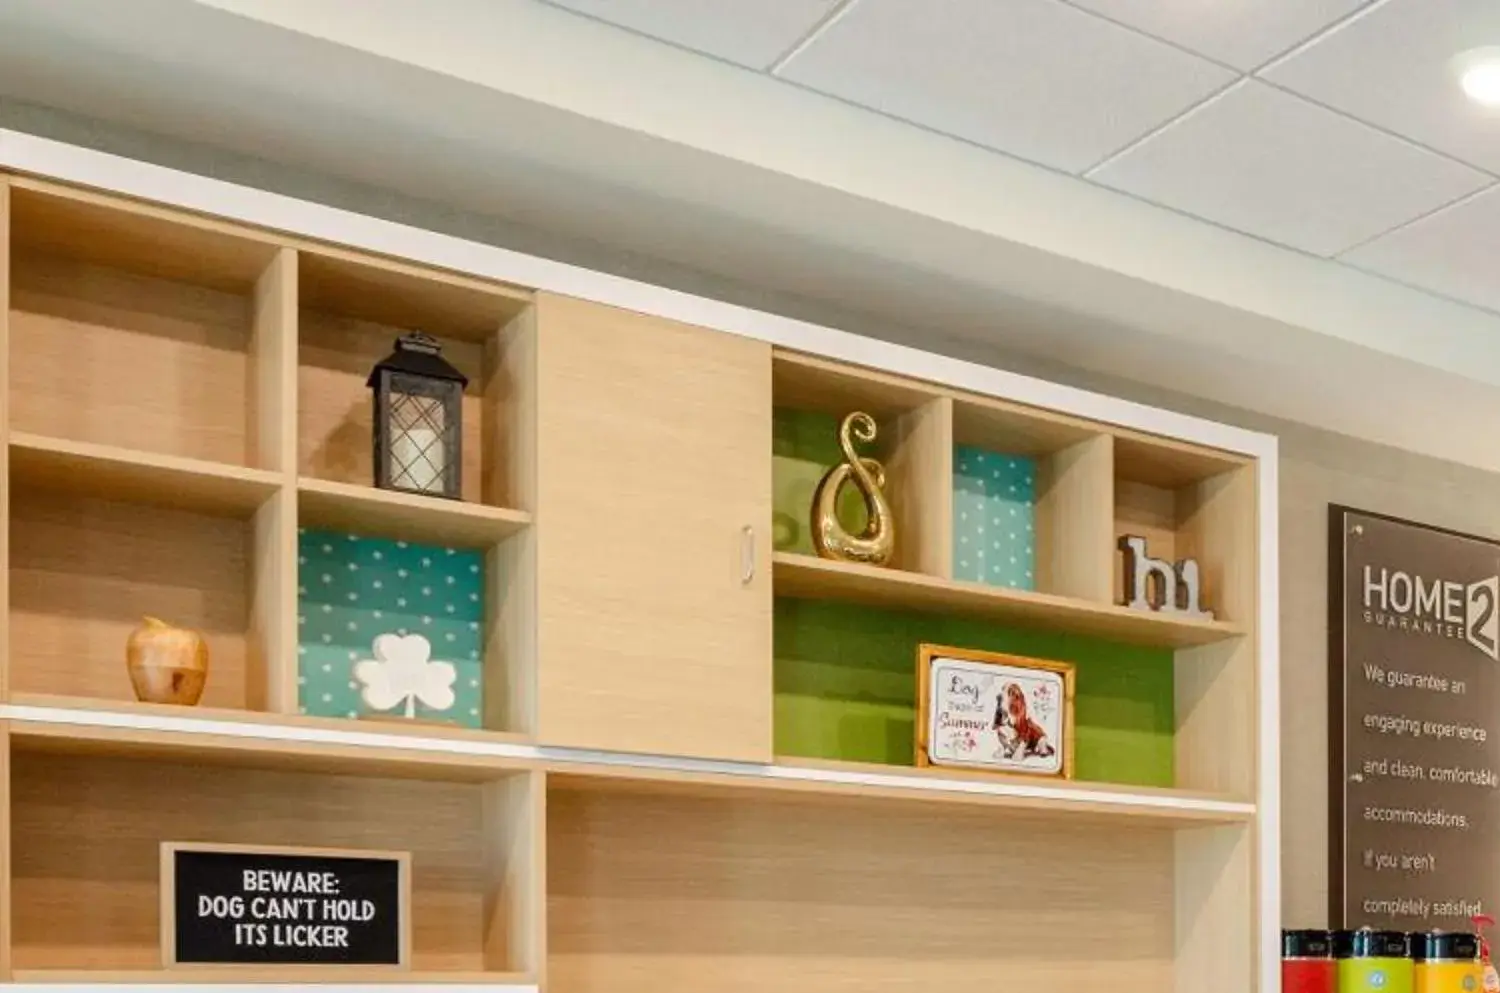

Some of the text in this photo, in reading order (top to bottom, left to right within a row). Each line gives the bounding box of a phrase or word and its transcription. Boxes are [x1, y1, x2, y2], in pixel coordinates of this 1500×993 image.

[1363, 611, 1465, 640] GUARANTEE
[1363, 662, 1466, 694] We guarantee an
[1363, 714, 1487, 741] engaging experience
[1364, 759, 1387, 775] and
[1429, 766, 1499, 787] comfortable
[1375, 852, 1399, 871] you
[1402, 852, 1436, 871] aren't
[243, 869, 341, 894] BEWARE:
[198, 895, 376, 921] DOG CAN'T HOLD
[1364, 897, 1431, 920] completely
[235, 924, 349, 947] ITS LICKER
